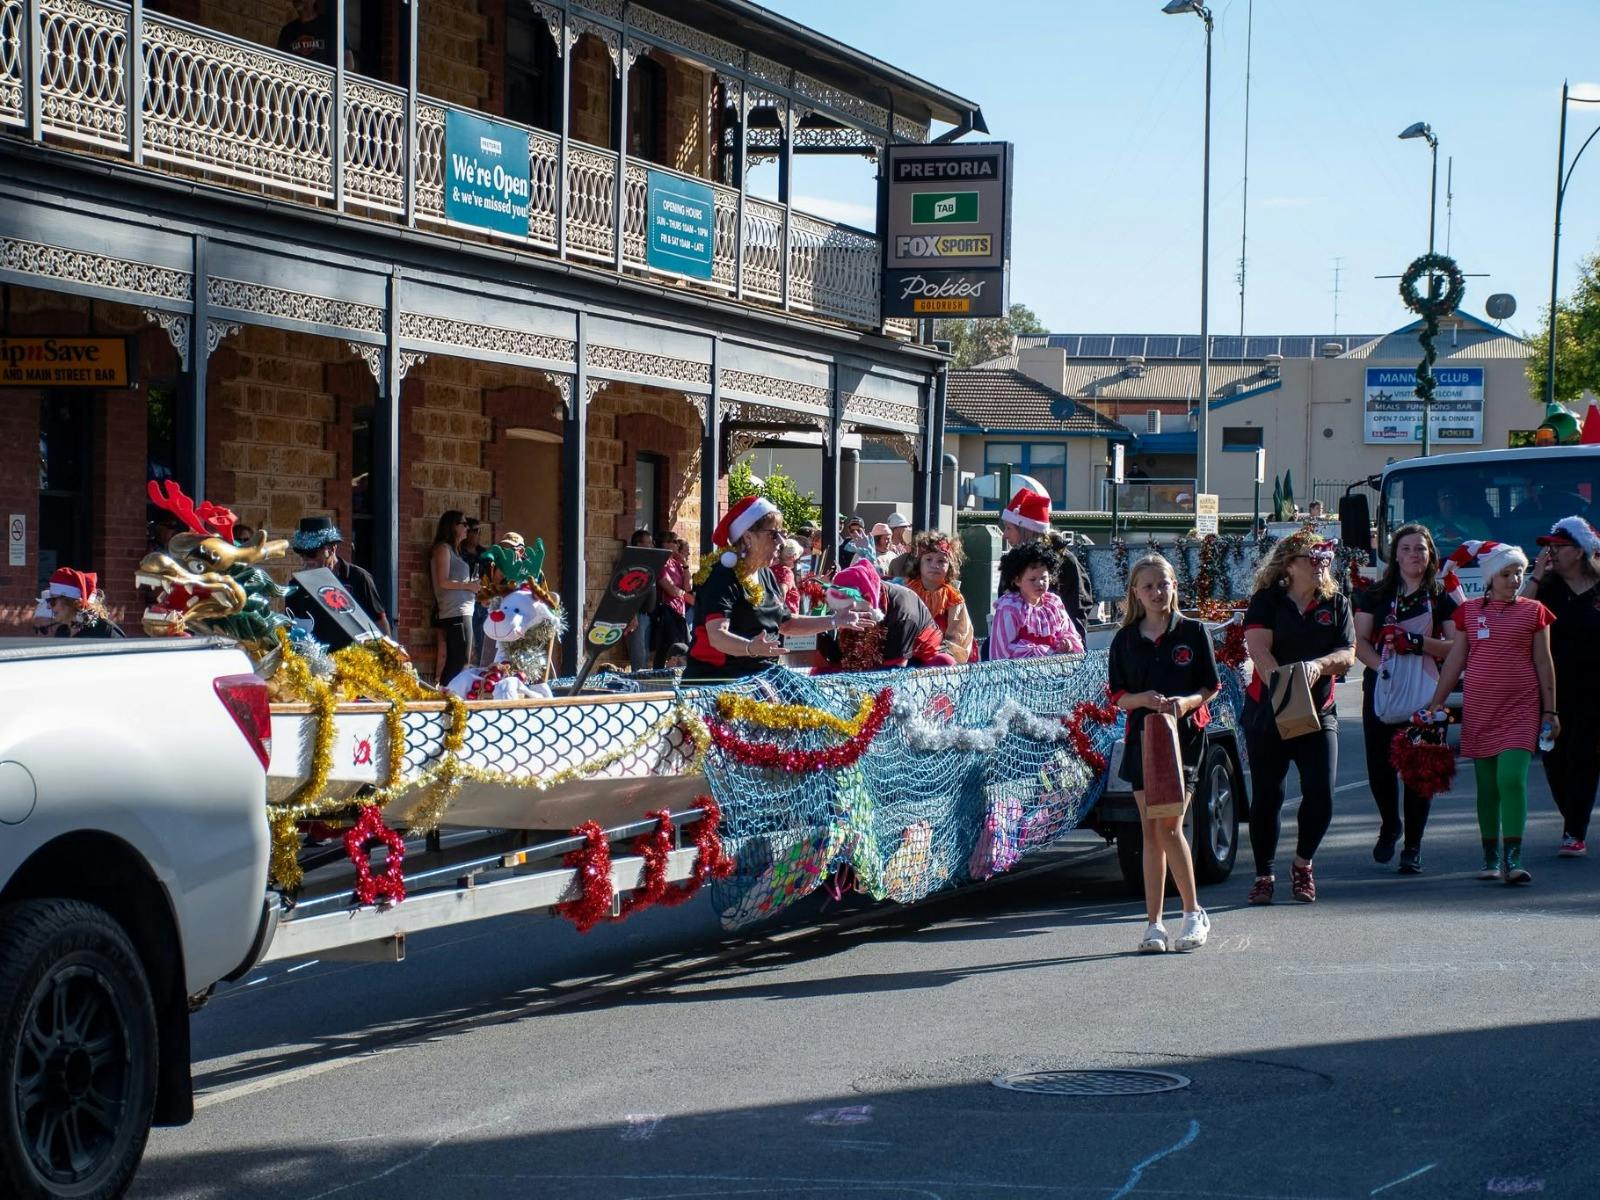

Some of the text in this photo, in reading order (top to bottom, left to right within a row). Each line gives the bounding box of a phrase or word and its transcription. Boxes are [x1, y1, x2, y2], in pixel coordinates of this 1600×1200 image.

[452, 154, 528, 199] We're Open
[901, 161, 992, 177] PRETORIA
[452, 186, 460, 202] &
[461, 191, 483, 206] we've
[483, 195, 511, 214] missed
[663, 200, 703, 220] OPENING HOURS
[937, 204, 954, 213] TAB
[656, 216, 665, 226] SUN
[669, 219, 682, 231] THURS
[693, 243, 704, 253] LATE
[896, 236, 988, 257] FOX SPORTS
[900, 274, 986, 300] Pokies
[920, 301, 963, 310] GOLDRUSH
[4, 368, 115, 380] AND MAIN STREET BAR
[1379, 373, 1470, 383] MANN CLUB
[1435, 390, 1464, 398] ELCOME
